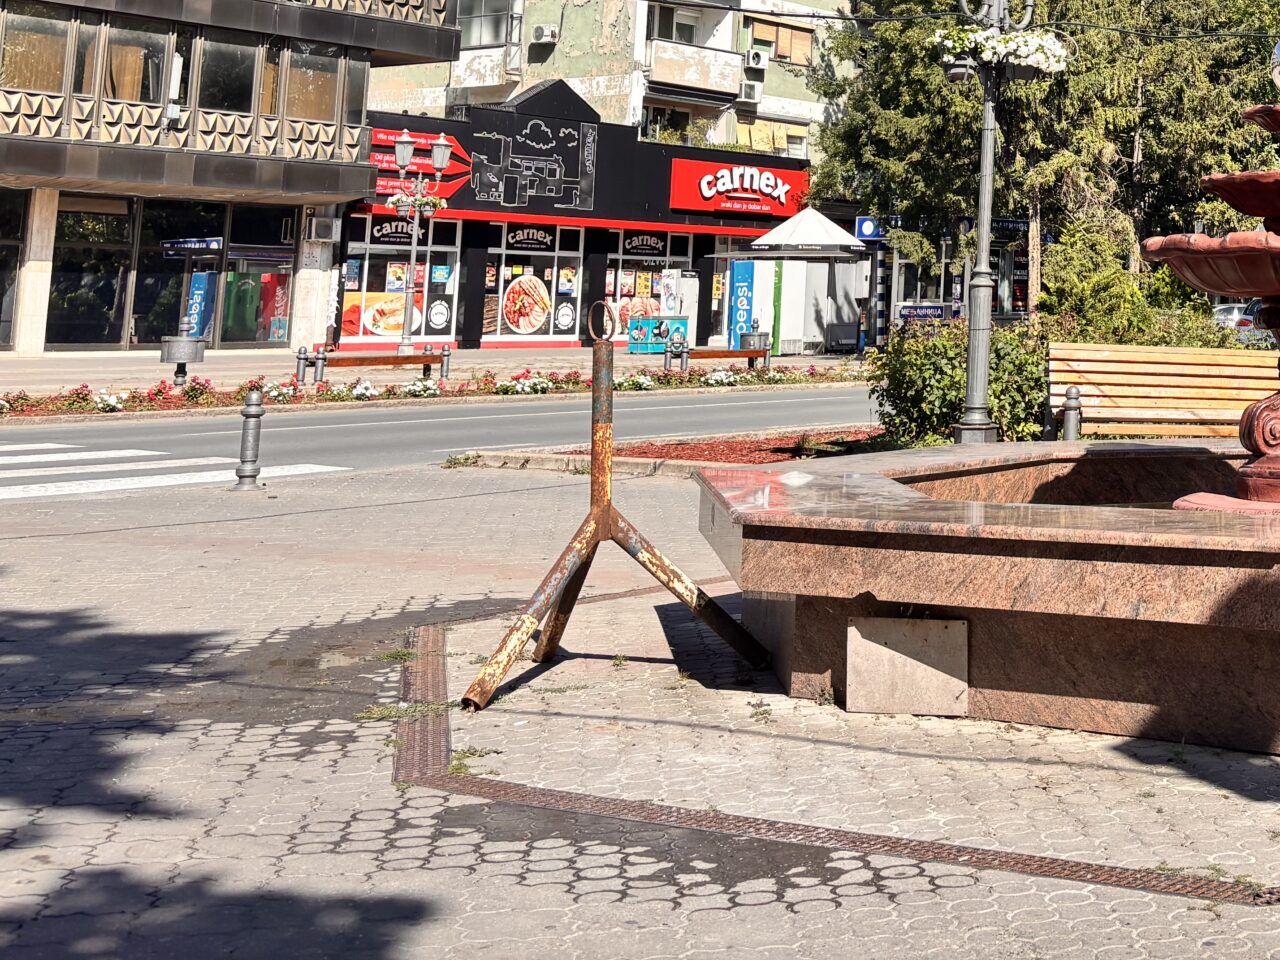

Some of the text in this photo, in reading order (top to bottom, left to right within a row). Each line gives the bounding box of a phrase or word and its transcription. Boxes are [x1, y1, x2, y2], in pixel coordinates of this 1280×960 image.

[700, 166, 791, 204] carnex
[373, 221, 425, 239] carnex
[508, 228, 553, 245] carnex
[625, 235, 664, 251] carnex
